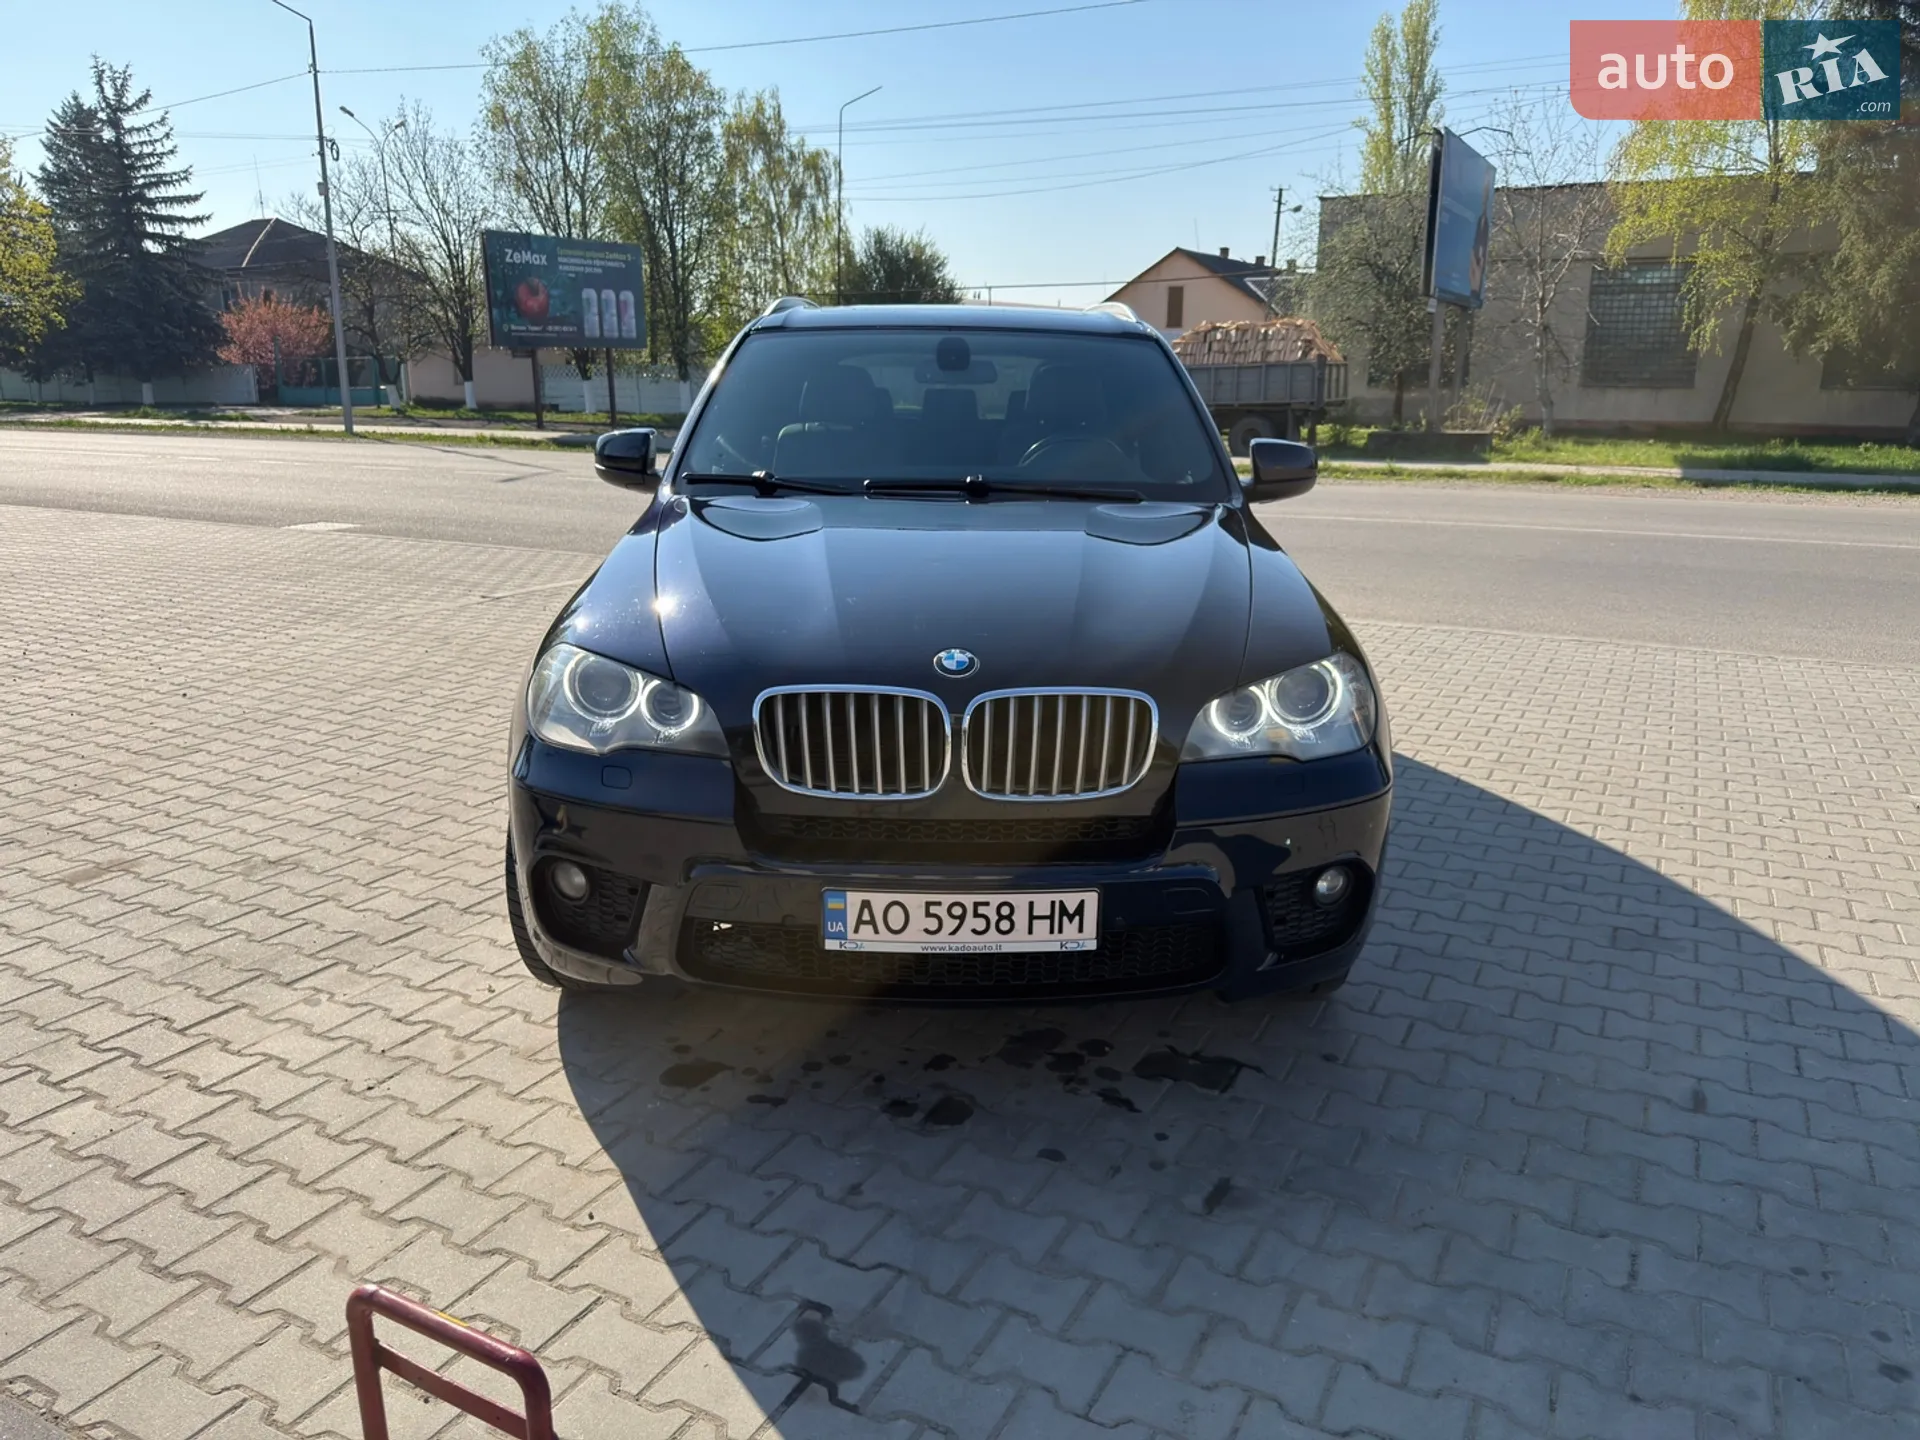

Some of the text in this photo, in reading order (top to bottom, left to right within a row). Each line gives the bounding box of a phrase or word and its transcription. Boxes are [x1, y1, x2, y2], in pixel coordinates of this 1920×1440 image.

[504, 248, 548, 266] ZeMax
[853, 899, 1085, 936] AO 5958 HM
[827, 921, 845, 932] UA
[920, 943, 1002, 952] www.kadoauto.lt
